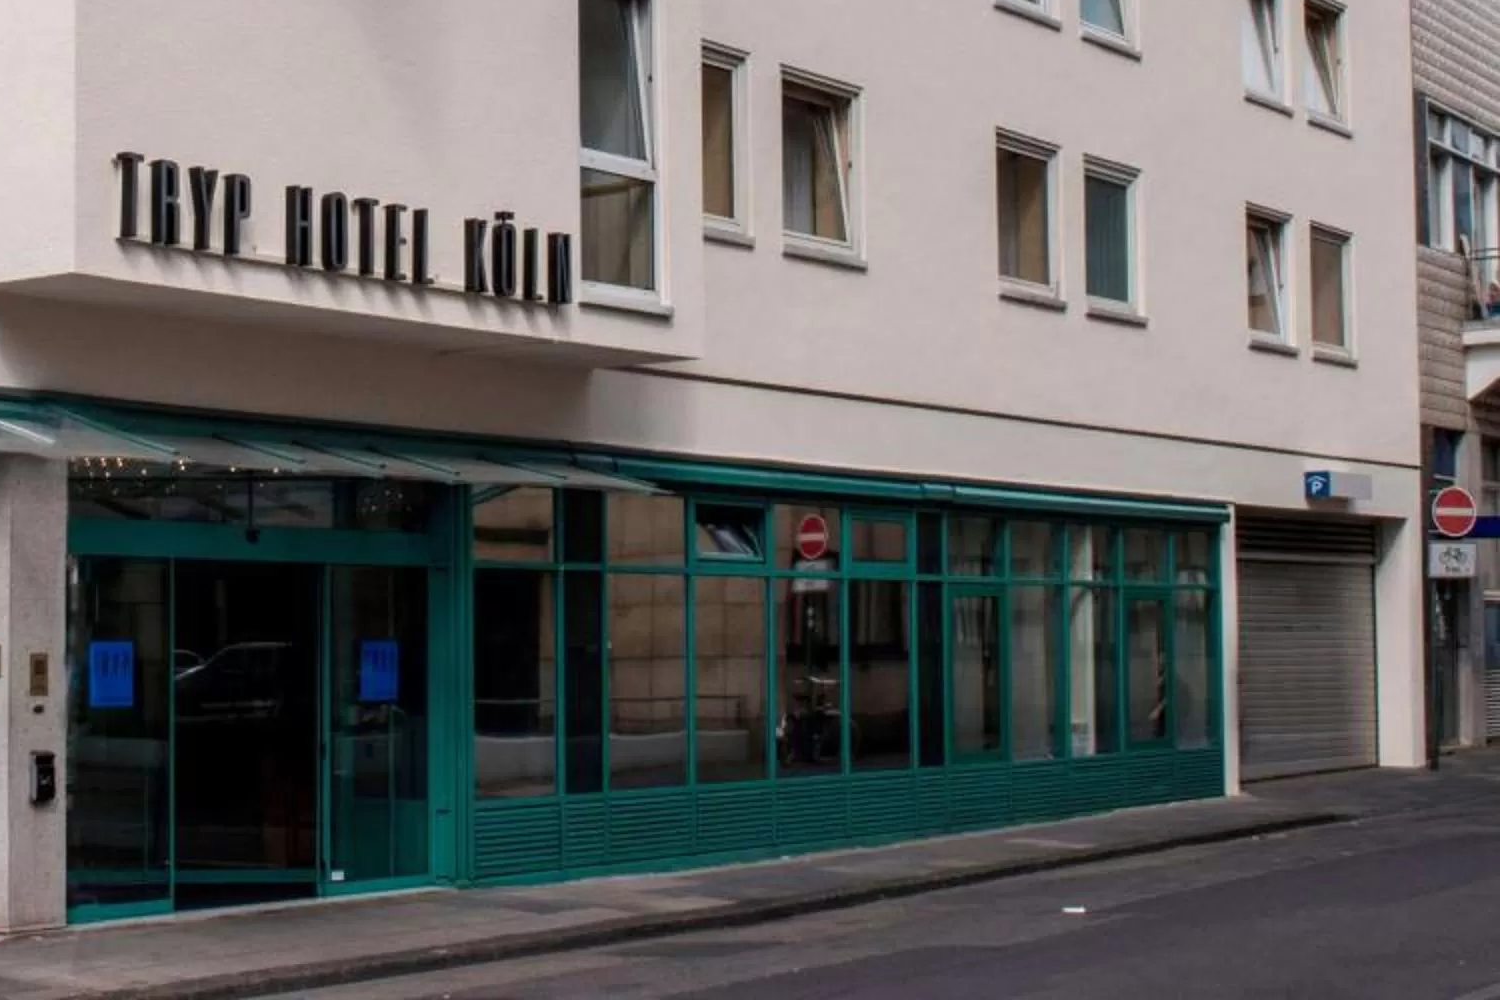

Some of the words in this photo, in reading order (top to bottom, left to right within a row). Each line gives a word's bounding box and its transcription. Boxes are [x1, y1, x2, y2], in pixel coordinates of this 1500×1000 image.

[113, 151, 251, 255] TRYP
[285, 185, 434, 285] HOTEL
[464, 211, 573, 304] KÖLN
